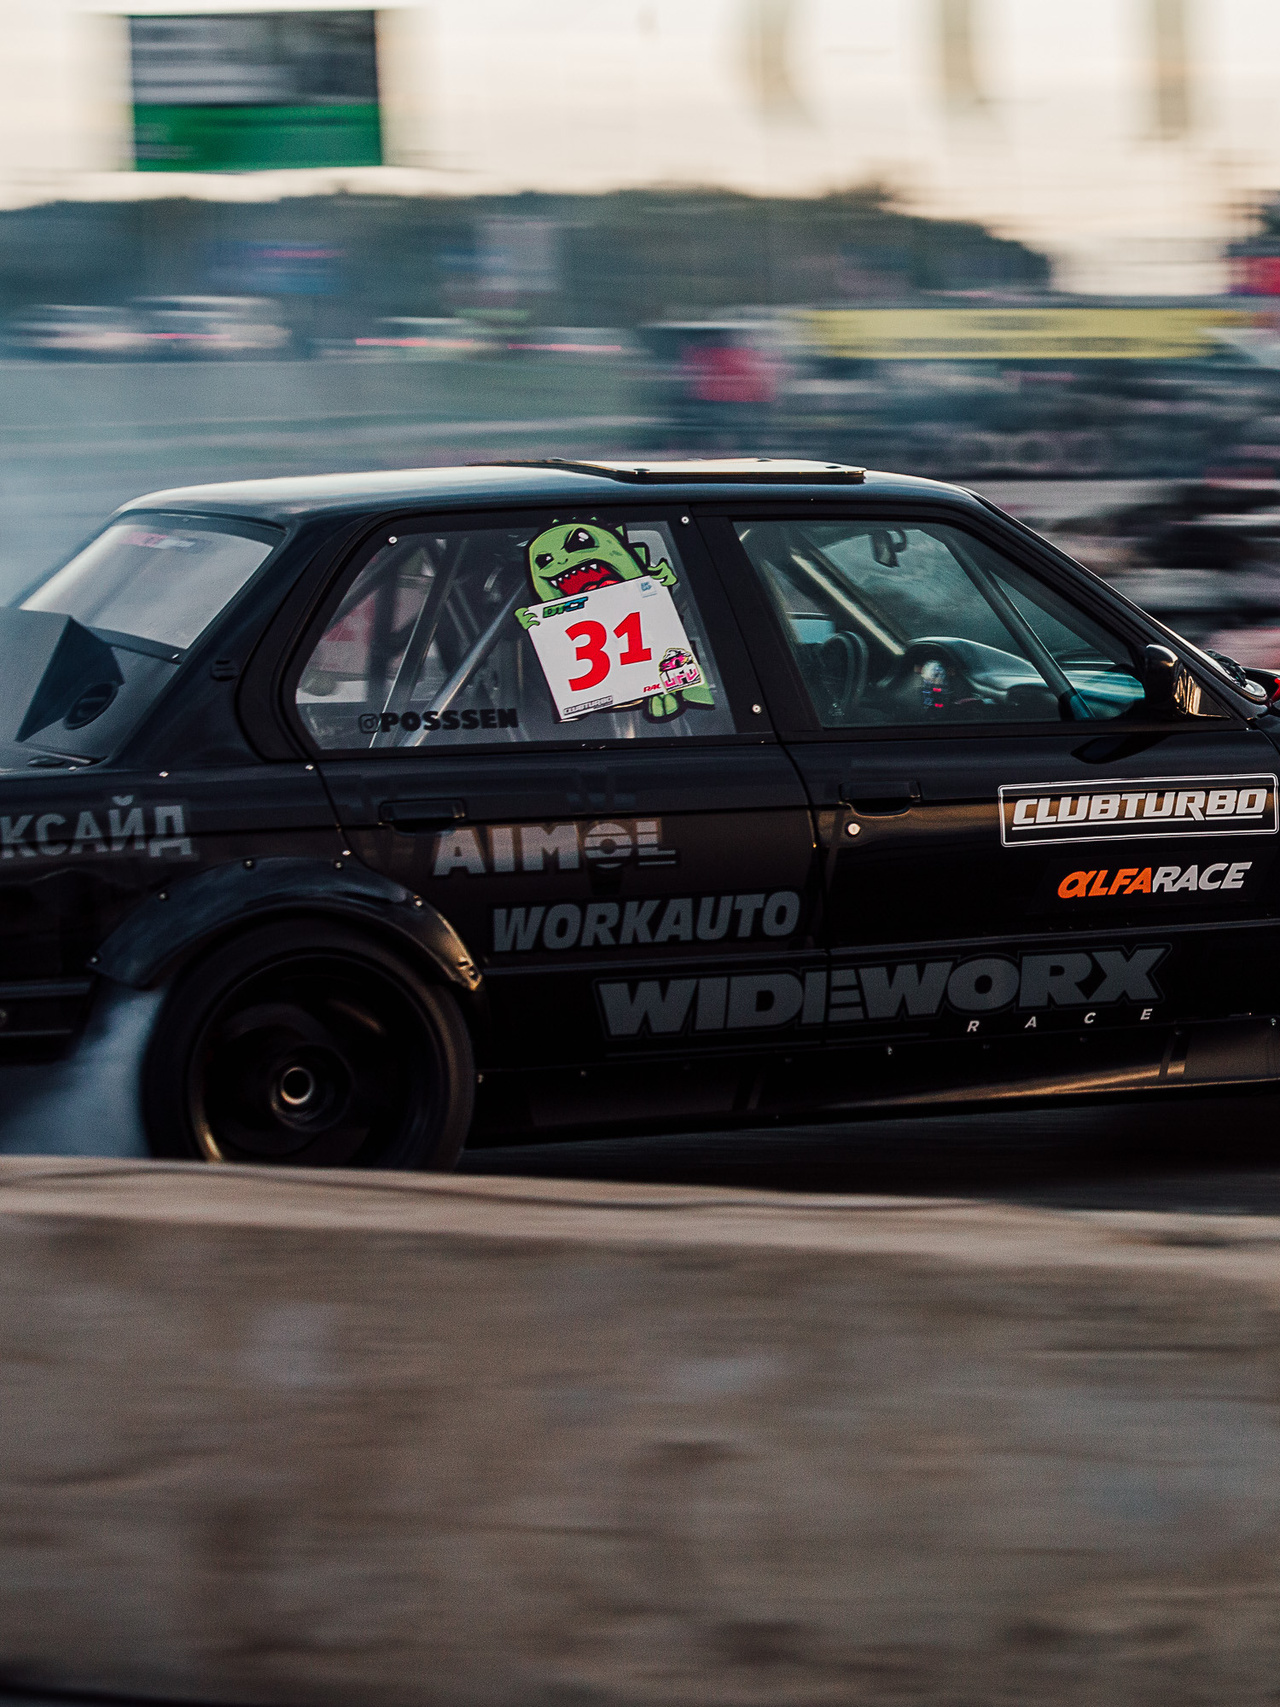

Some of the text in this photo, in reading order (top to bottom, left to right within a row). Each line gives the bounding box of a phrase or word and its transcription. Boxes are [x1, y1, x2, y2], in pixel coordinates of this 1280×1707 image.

[564, 611, 653, 692] 31
[1013, 788, 1268, 826] CLUBTURBO
[432, 820, 677, 876] AIMOL
[493, 890, 801, 951] WORKAUTO
[599, 947, 1167, 1036] WIDEWORX
[966, 1007, 1154, 1033] RACE
